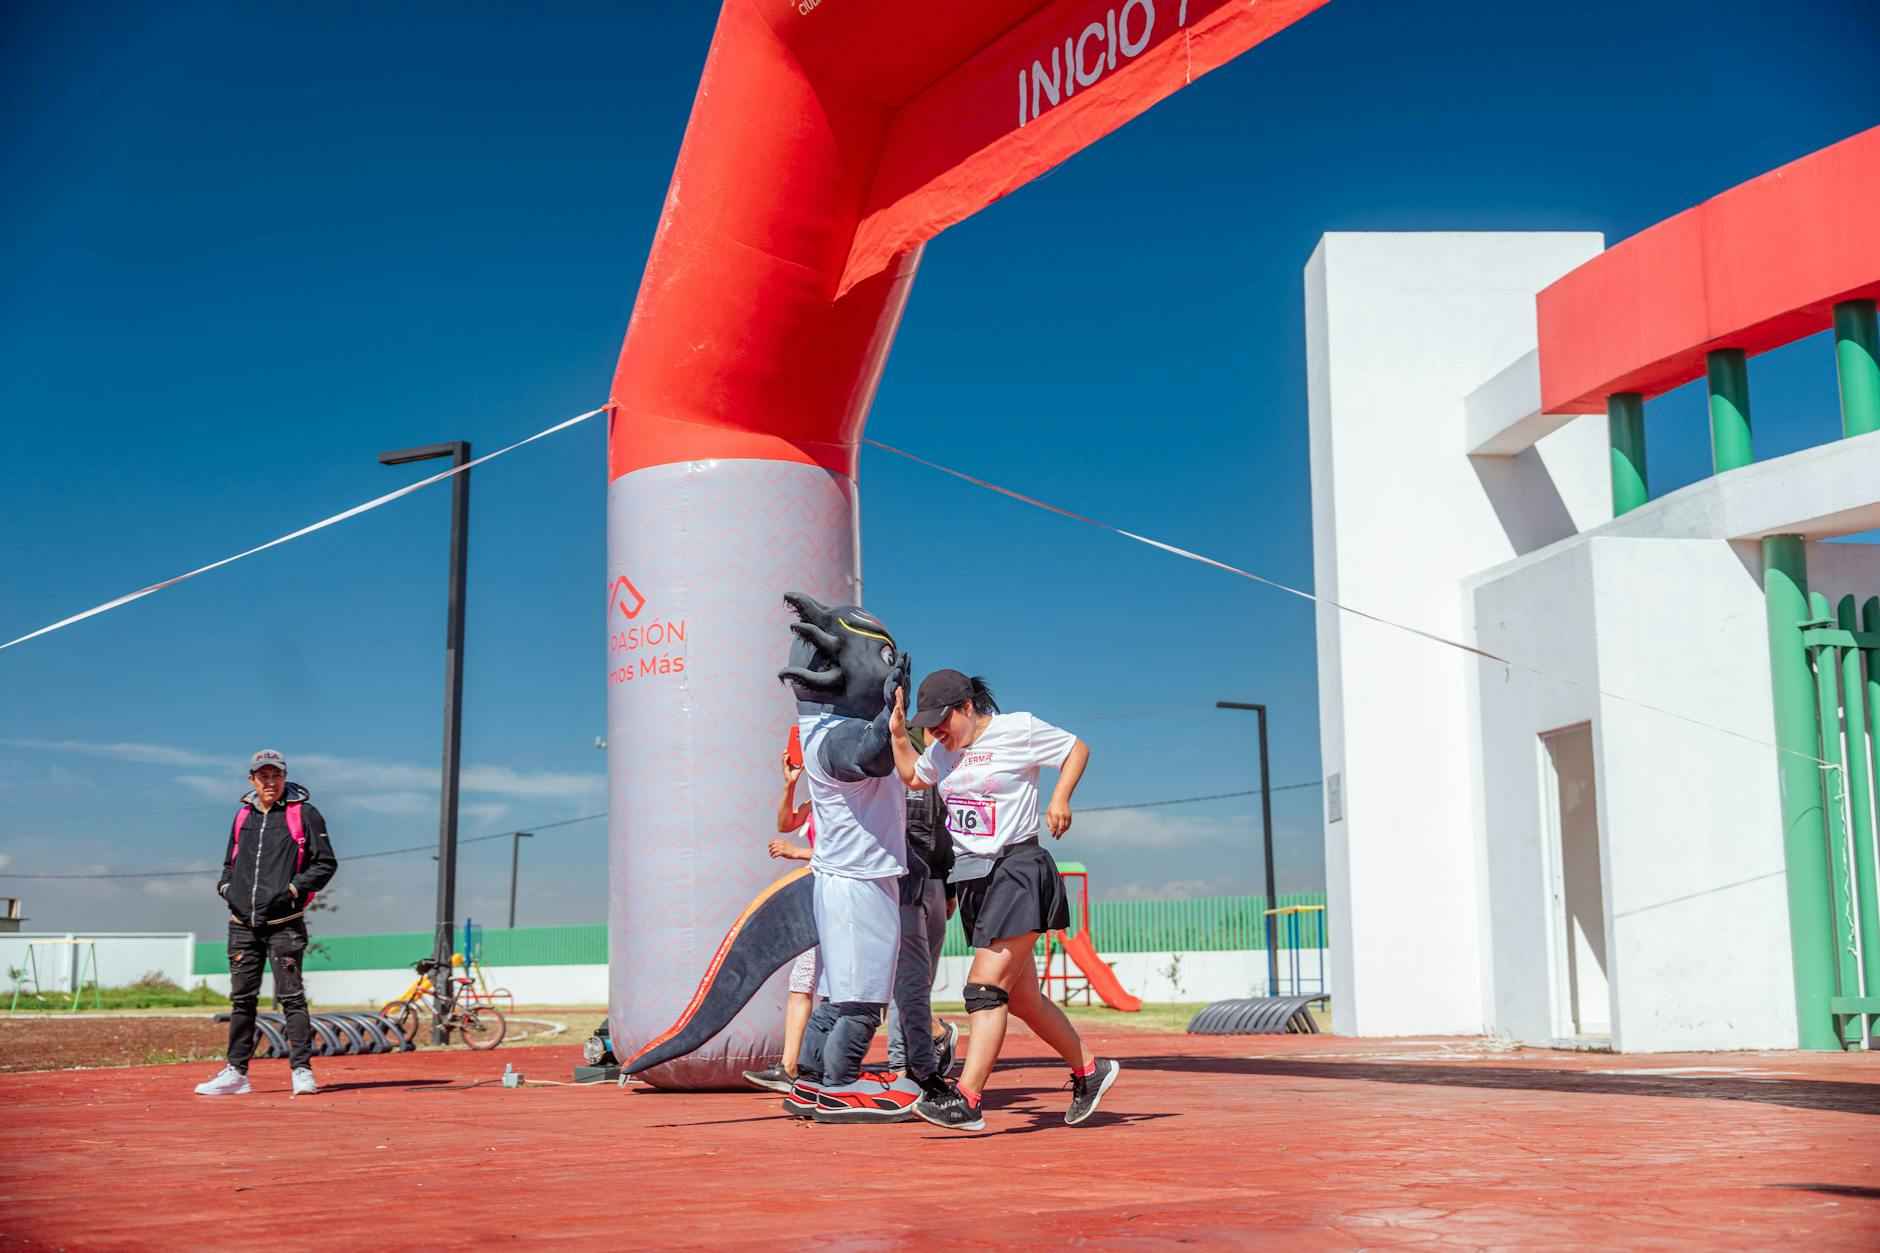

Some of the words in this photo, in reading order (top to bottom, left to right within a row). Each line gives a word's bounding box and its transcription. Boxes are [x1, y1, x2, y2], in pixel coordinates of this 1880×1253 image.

[1018, 0, 1156, 127] INICIO
[639, 652, 685, 678] Más
[956, 809, 977, 829] 16
